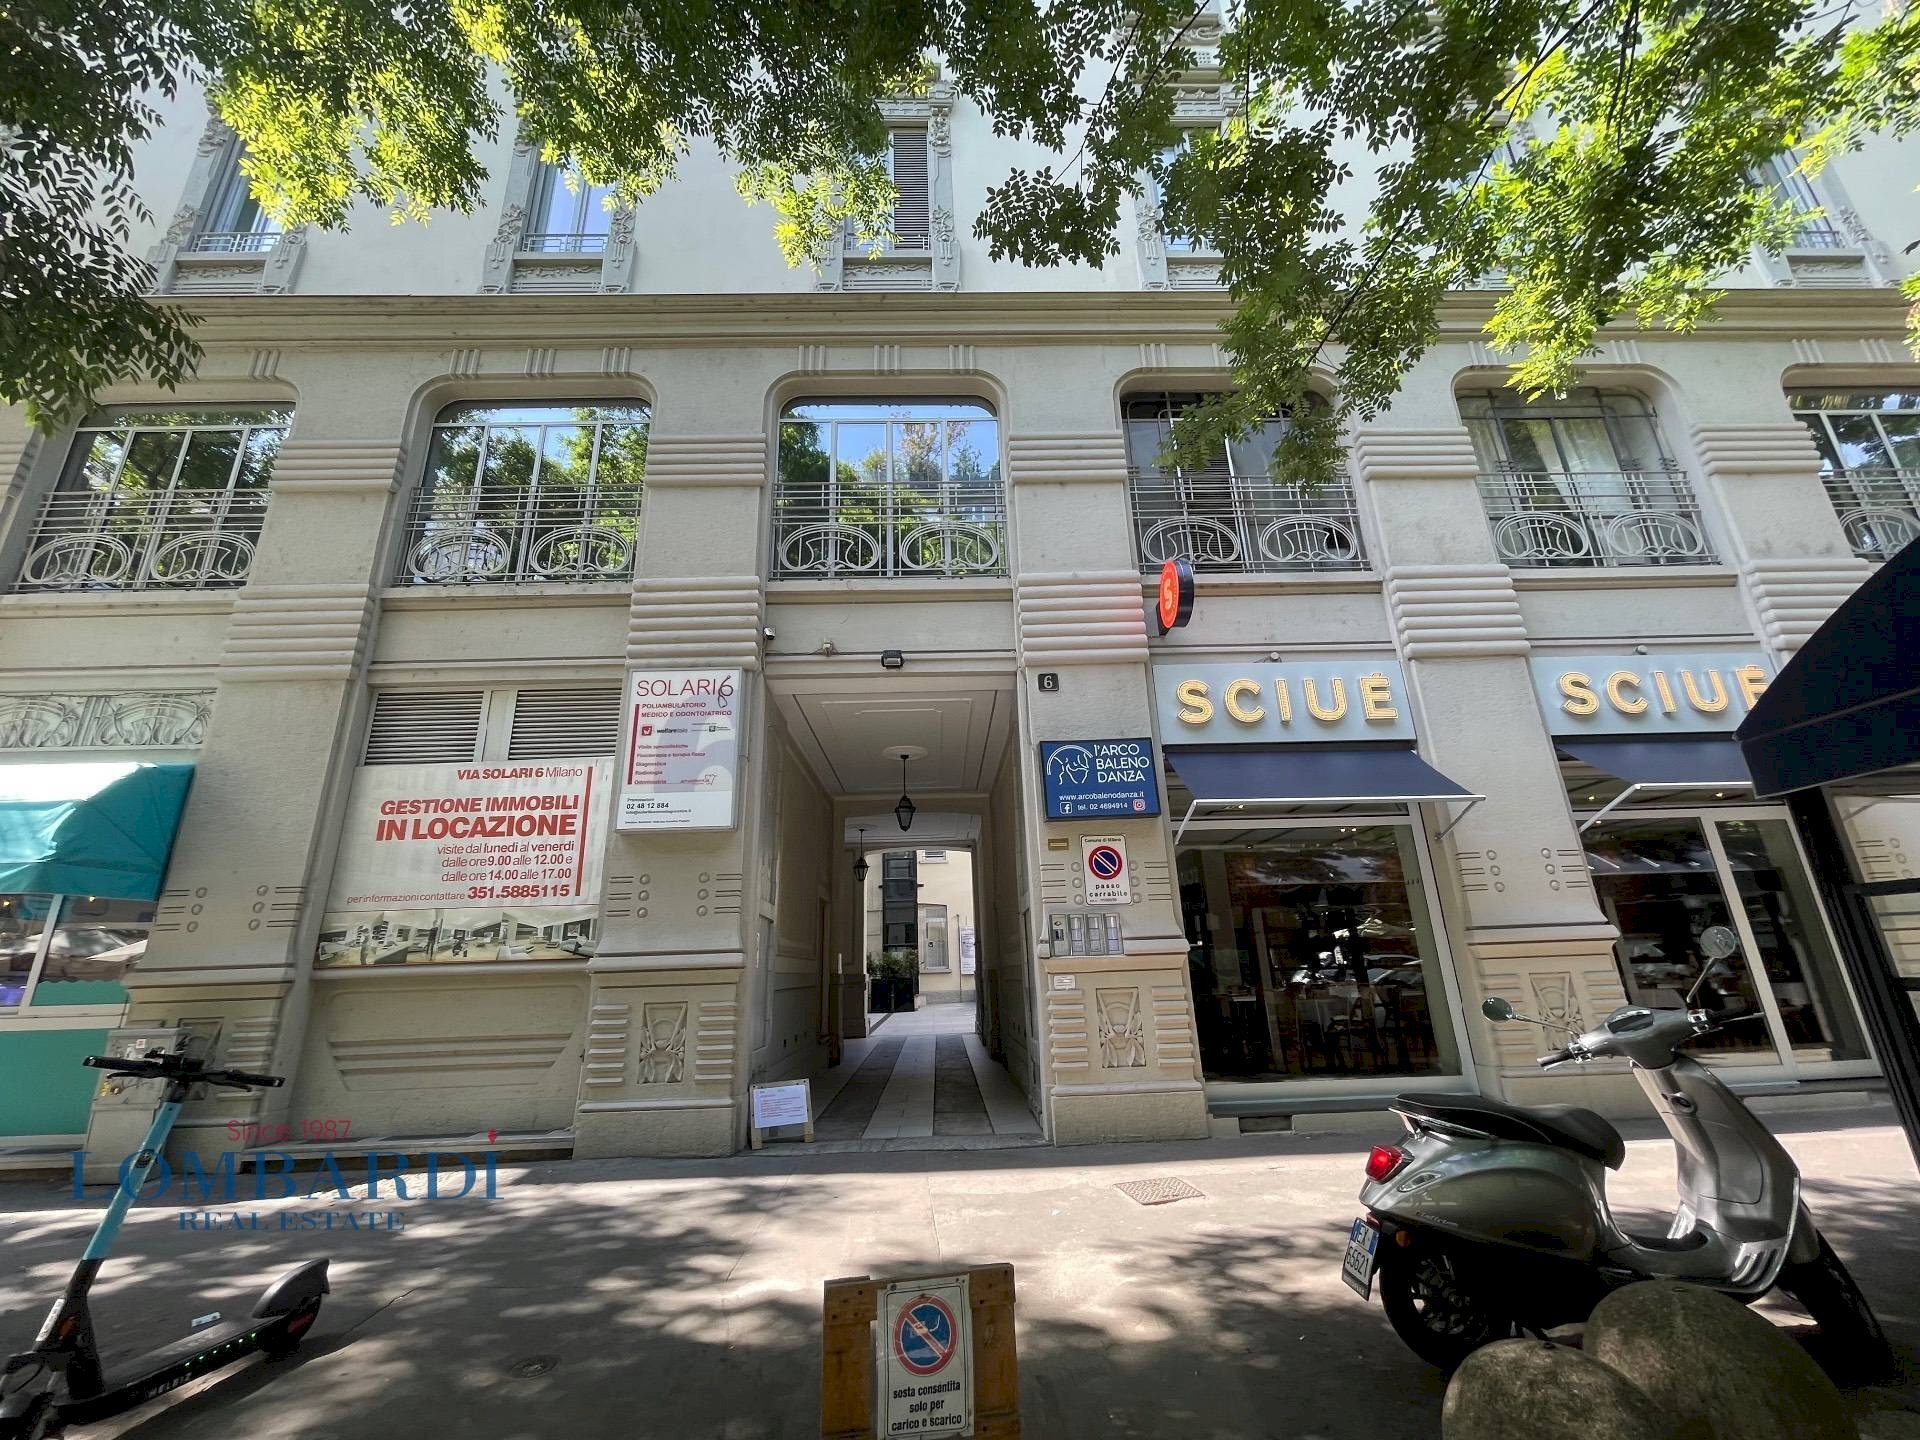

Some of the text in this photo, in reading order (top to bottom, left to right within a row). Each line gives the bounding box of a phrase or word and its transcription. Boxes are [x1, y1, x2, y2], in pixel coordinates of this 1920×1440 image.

[1043, 676, 1053, 690] 6
[1096, 756, 1150, 770] BALENO
[457, 767, 583, 780] VIA SOLARI 6 Milano
[1097, 770, 1146, 784] DANZA
[1059, 791, 1144, 801] www.arcobalenodanza.it
[380, 794, 580, 815] GESTIONE IMMOBILI
[376, 814, 577, 841] IN LOCAZIONE
[437, 845, 464, 855] visite
[465, 843, 482, 854] dal
[519, 842, 530, 852] al
[441, 854, 573, 868] dalle ore 9.00 alle 12.00 e
[441, 868, 572, 883] dalle ore 14.00 alle 17.00
[346, 897, 361, 905] per
[419, 892, 466, 901] contattare
[467, 884, 570, 900] 351.5885115
[1356, 1224, 1369, 1247] EX
[893, 1380, 961, 1398] sosta consentita
[909, 1399, 945, 1413] solo per
[891, 1414, 962, 1431] carico e scarico
